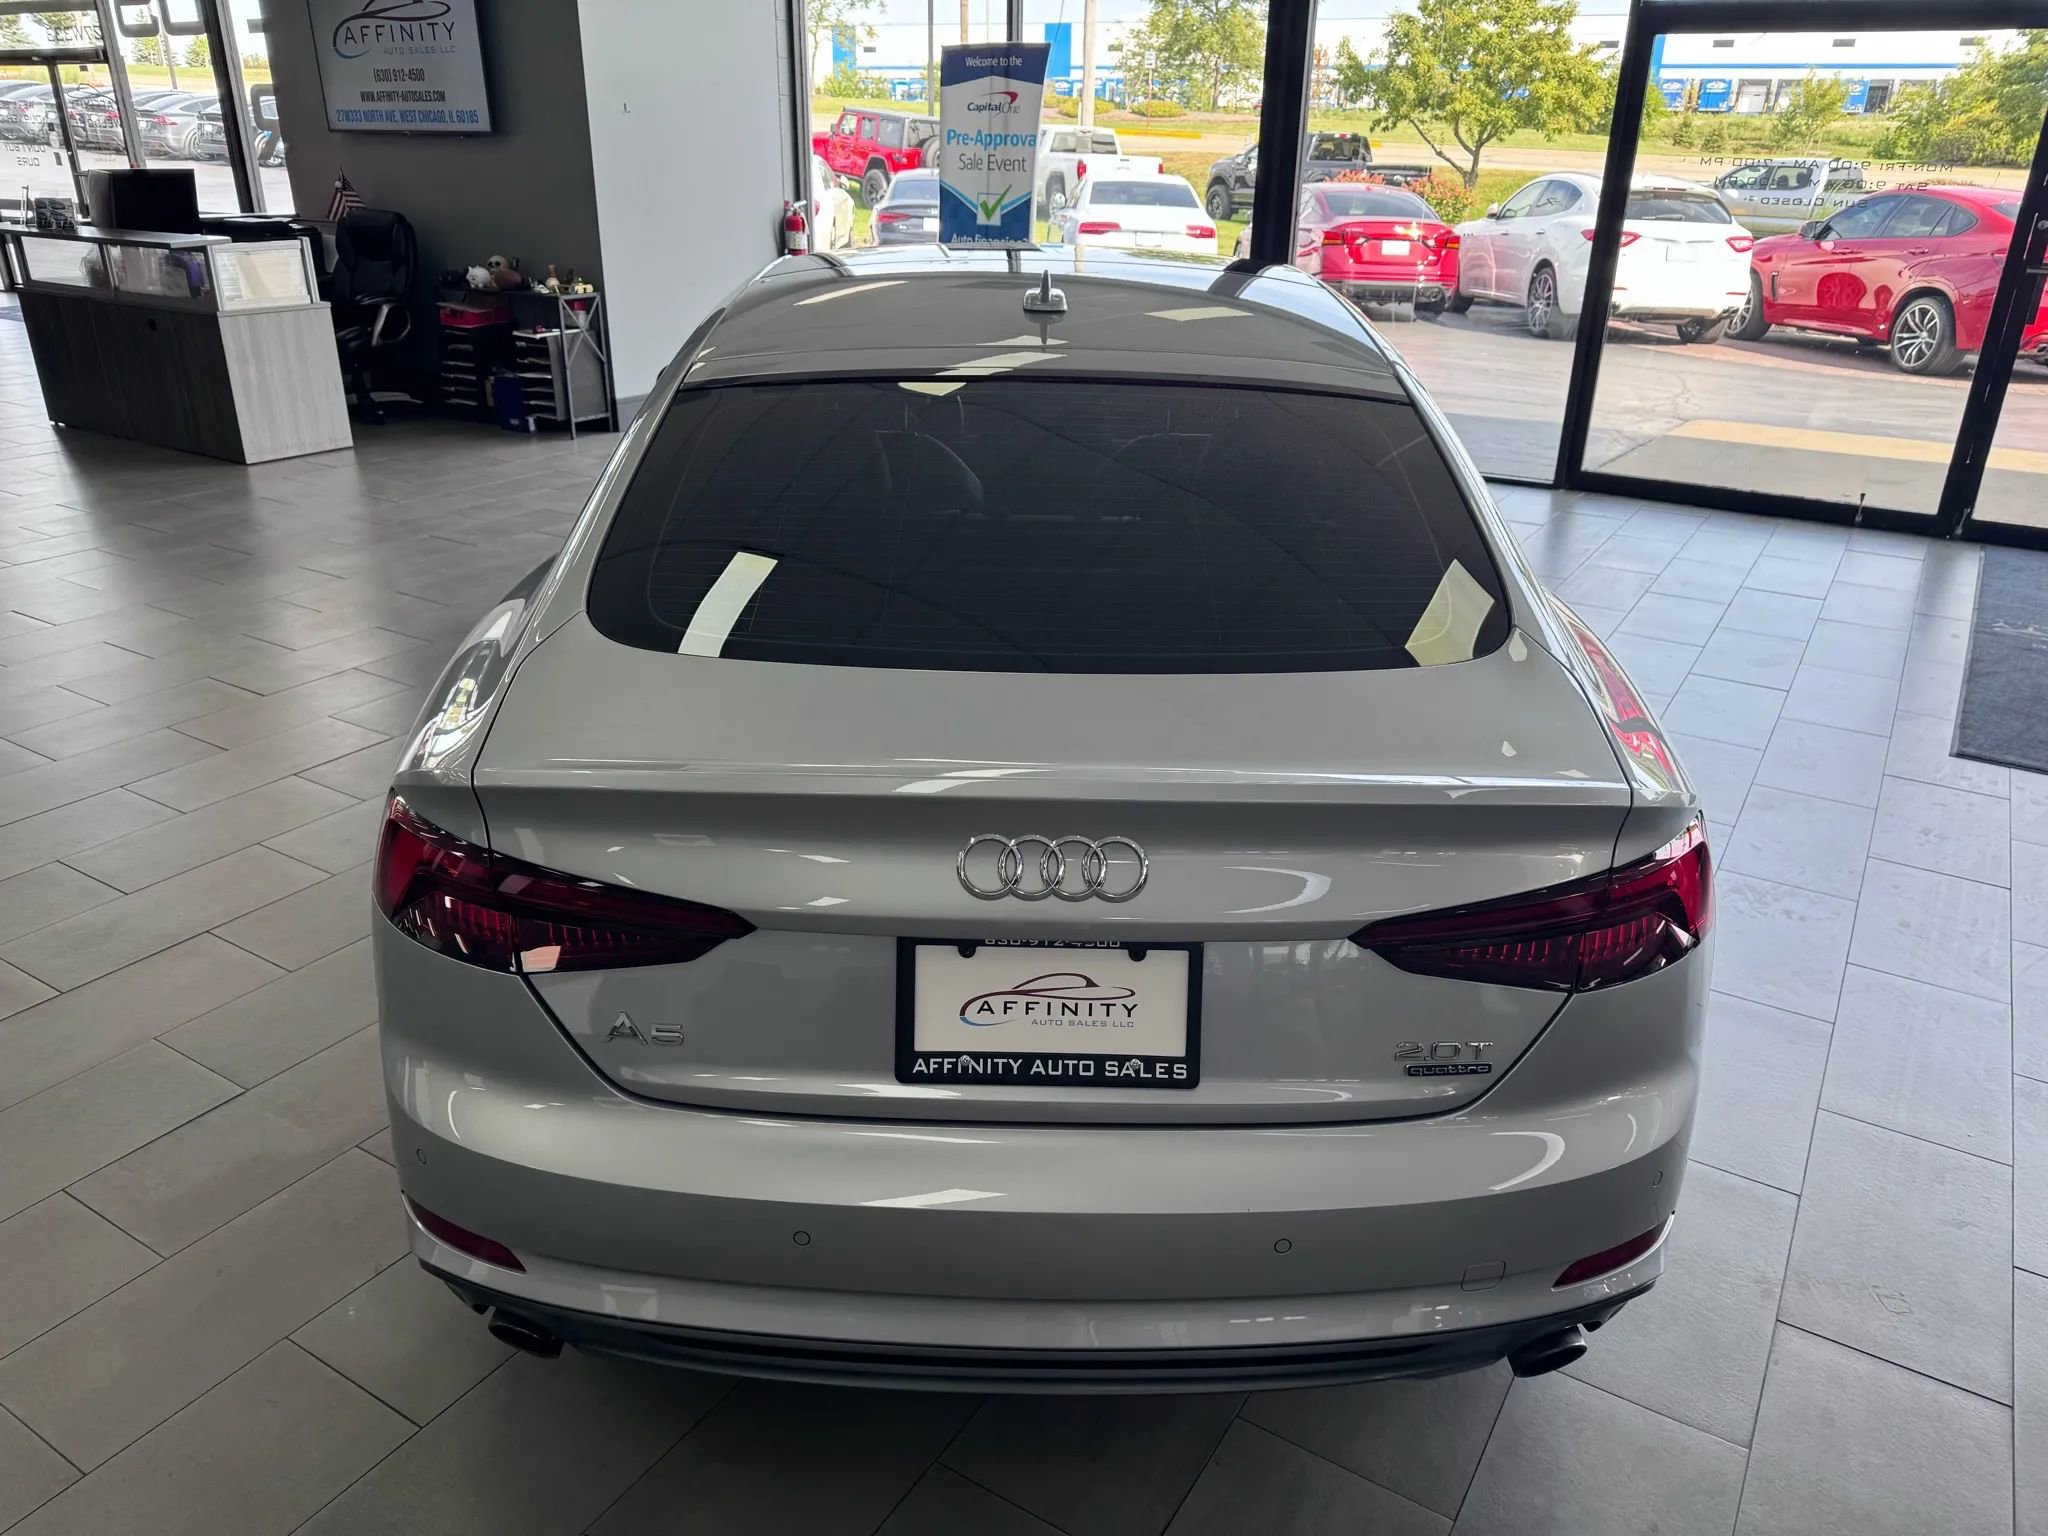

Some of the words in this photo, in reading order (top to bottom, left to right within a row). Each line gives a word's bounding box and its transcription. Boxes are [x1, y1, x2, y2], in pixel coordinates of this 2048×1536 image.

[344, 21, 456, 45] AFFINITY
[383, 46, 404, 55] AUTO
[408, 45, 435, 55] SALES
[439, 45, 457, 54] LLC
[964, 56, 999, 67] Welcome
[1000, 57, 1008, 66] to
[1009, 55, 1023, 66] the
[373, 67, 392, 83] (630)
[392, 67, 426, 82] 912-4500
[359, 90, 448, 103] WWW.AFFINITY-AUTOSALES.COM
[336, 109, 362, 123] 27W333
[362, 109, 384, 123] NORTH
[400, 110, 416, 124] WEST
[456, 110, 479, 124] 60185
[946, 128, 1037, 151] Pre-Approva
[958, 153, 983, 171] Sale
[987, 154, 1027, 172] Event
[976, 1000, 1139, 1018] AFFINITY
[604, 1010, 685, 1047] A5
[1068, 1019, 1108, 1028] SALES
[1112, 1020, 1134, 1028] LLC
[1394, 1041, 1493, 1061] 2.0T
[912, 1057, 1024, 1075] AFFINITY
[1029, 1059, 1095, 1077] AUTO
[1104, 1060, 1188, 1080] SALES
[1408, 1065, 1490, 1076] quattro
